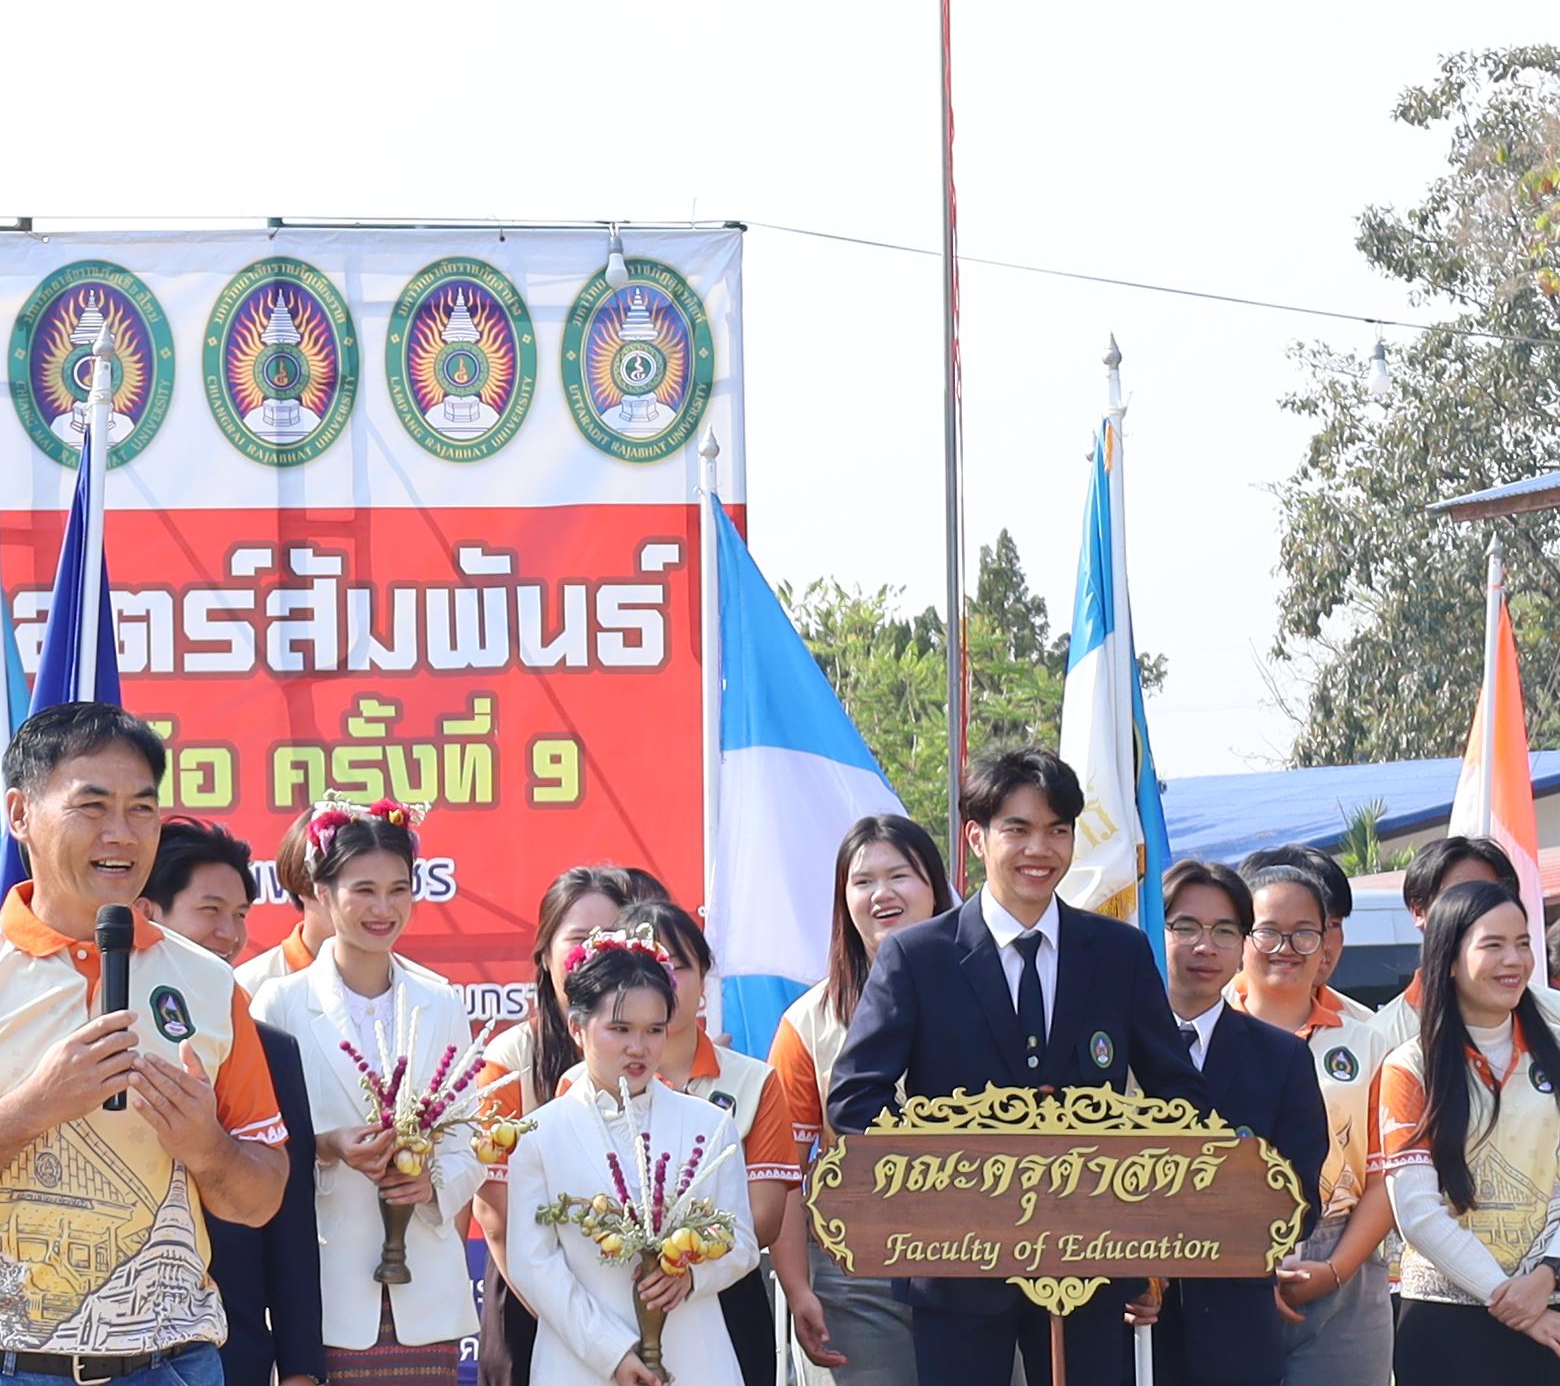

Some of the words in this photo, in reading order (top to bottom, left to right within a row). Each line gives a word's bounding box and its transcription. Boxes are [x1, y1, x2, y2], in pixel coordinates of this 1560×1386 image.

[15, 380, 36, 428] CHIANG
[32, 428, 56, 452] MAI
[131, 379, 171, 451] UNIVERSITY
[207, 375, 246, 446] CHIANGRAI
[247, 442, 313, 464] RAJABHAT
[316, 374, 355, 449] UNIVERSITY
[390, 376, 424, 439] LAMPANG
[426, 437, 489, 460] RAJABHAT
[490, 376, 533, 448] UNIVERSITY
[568, 383, 609, 446] UTTARADIT
[611, 439, 667, 459] RAJABHAT
[669, 382, 707, 446] UNIVERSITY
[273, 697, 493, 808] ครั้งที่
[532, 739, 580, 803] 9
[872, 1137, 1243, 1226] คณะครุศาสตร์
[883, 1231, 1001, 1270] Faculty
[1012, 1231, 1047, 1272] of
[1057, 1231, 1221, 1262] Education
